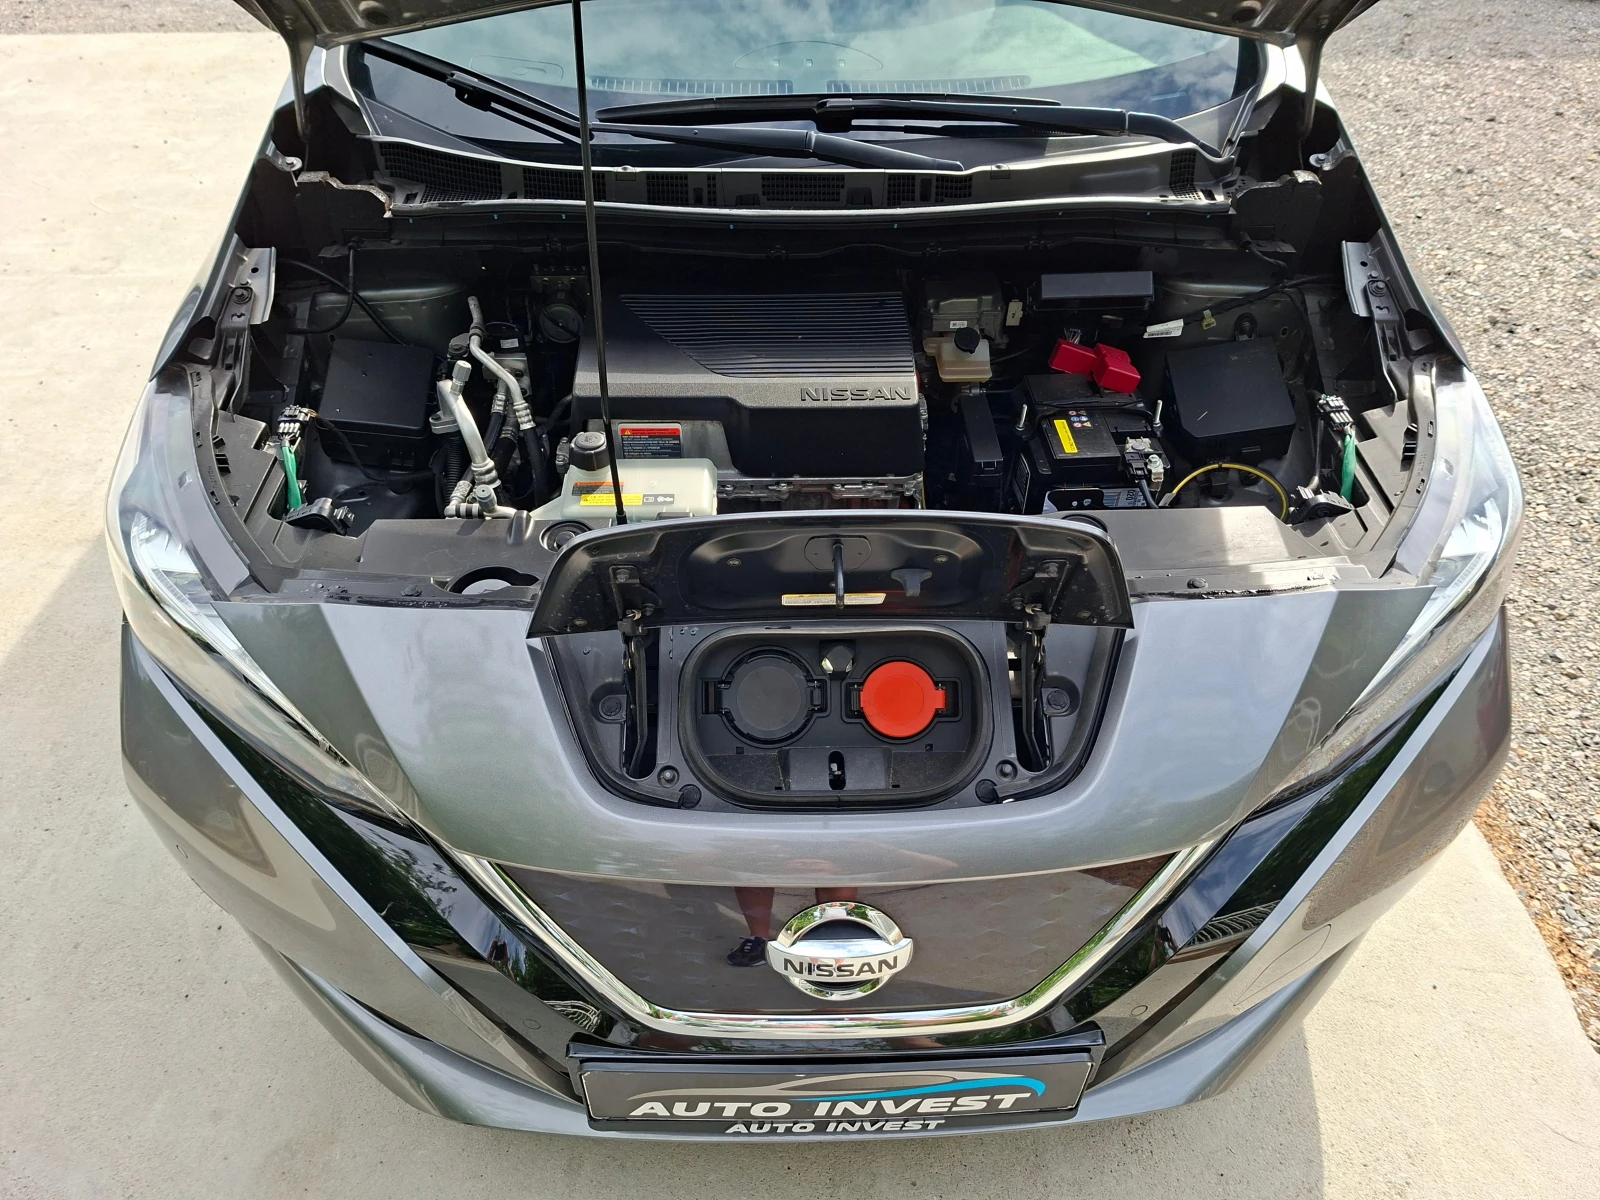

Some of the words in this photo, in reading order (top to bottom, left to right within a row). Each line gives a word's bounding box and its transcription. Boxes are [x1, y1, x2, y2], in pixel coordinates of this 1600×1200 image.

[800, 386, 911, 402] NISSAN
[783, 955, 898, 978] NISSAN
[629, 1101, 792, 1117] AUTO
[813, 1092, 1032, 1117] INVEST
[725, 1122, 815, 1134] AUTO
[826, 1119, 946, 1133] INVEST
